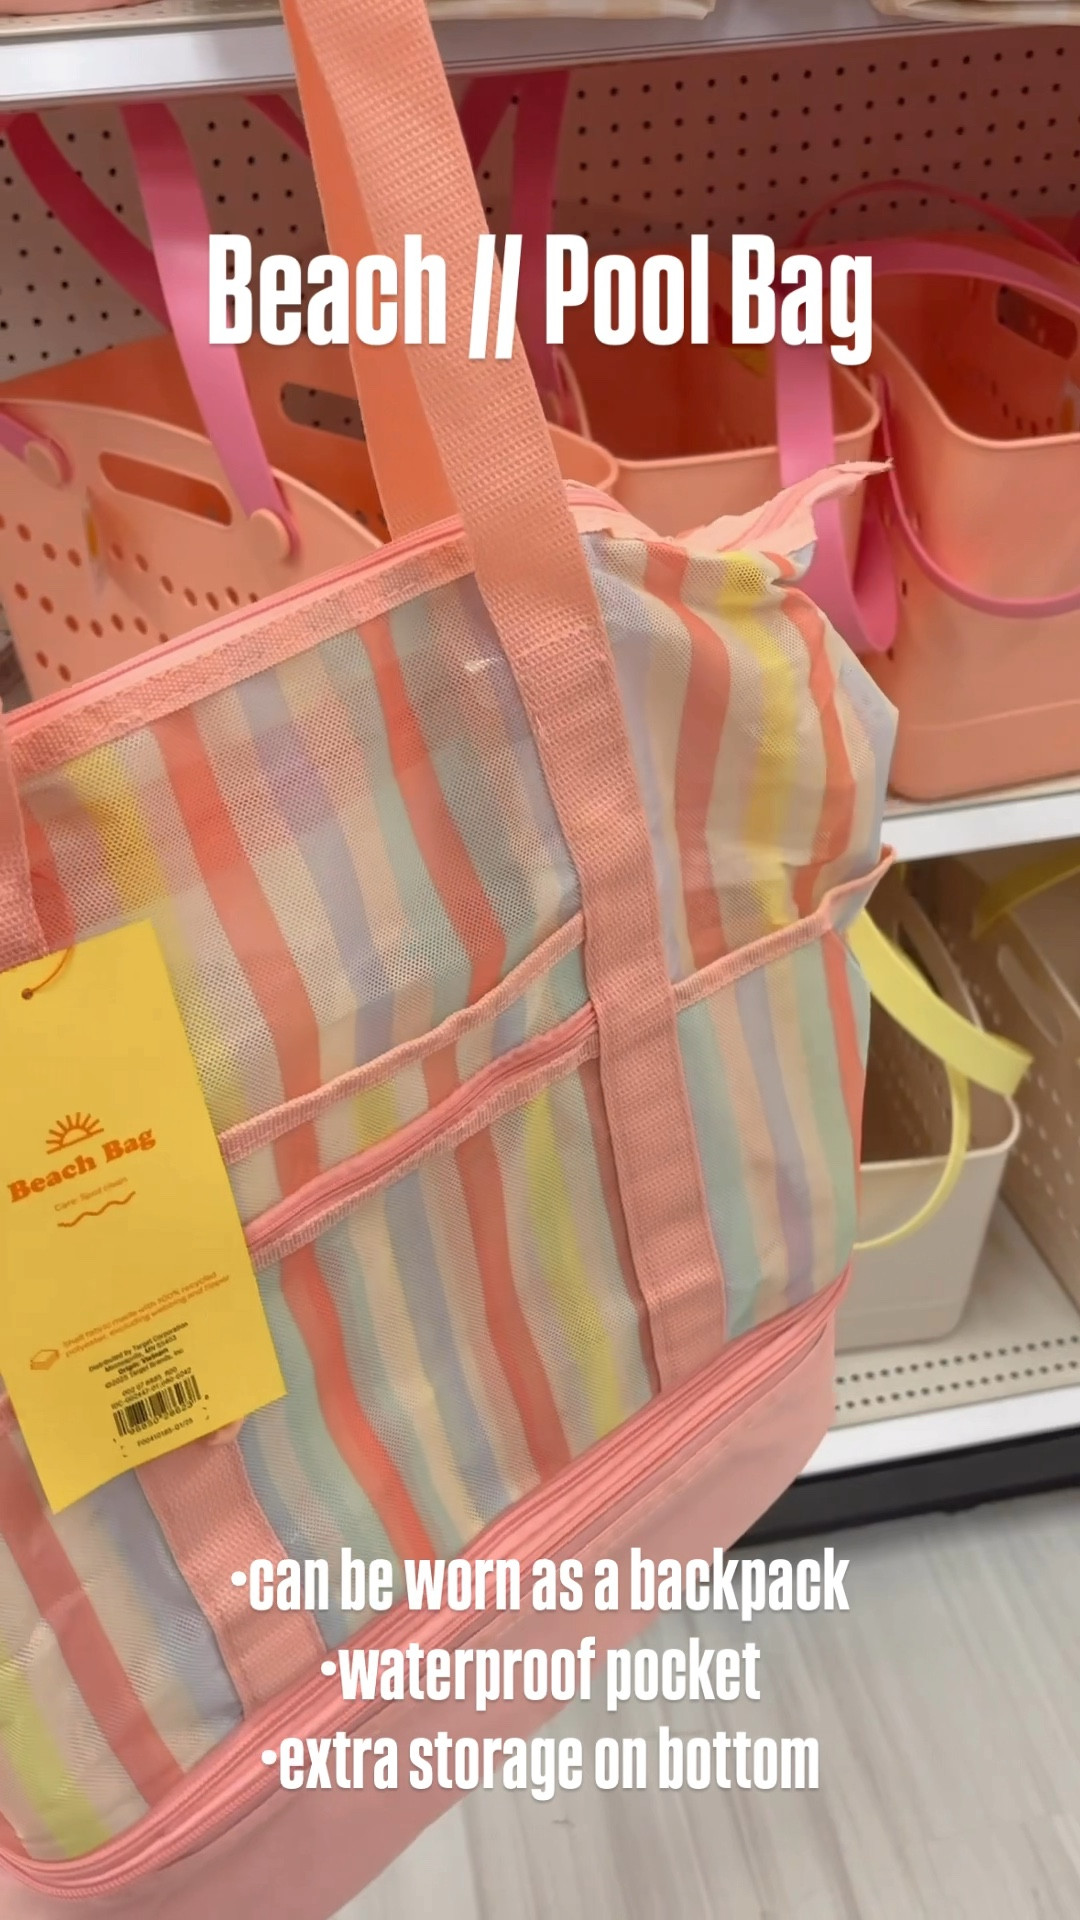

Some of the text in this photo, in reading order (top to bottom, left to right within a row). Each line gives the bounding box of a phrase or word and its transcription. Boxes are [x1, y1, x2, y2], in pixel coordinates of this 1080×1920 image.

[7, 1128, 156, 1203] Beach Bag
[132, 1337, 153, 1352] Target
